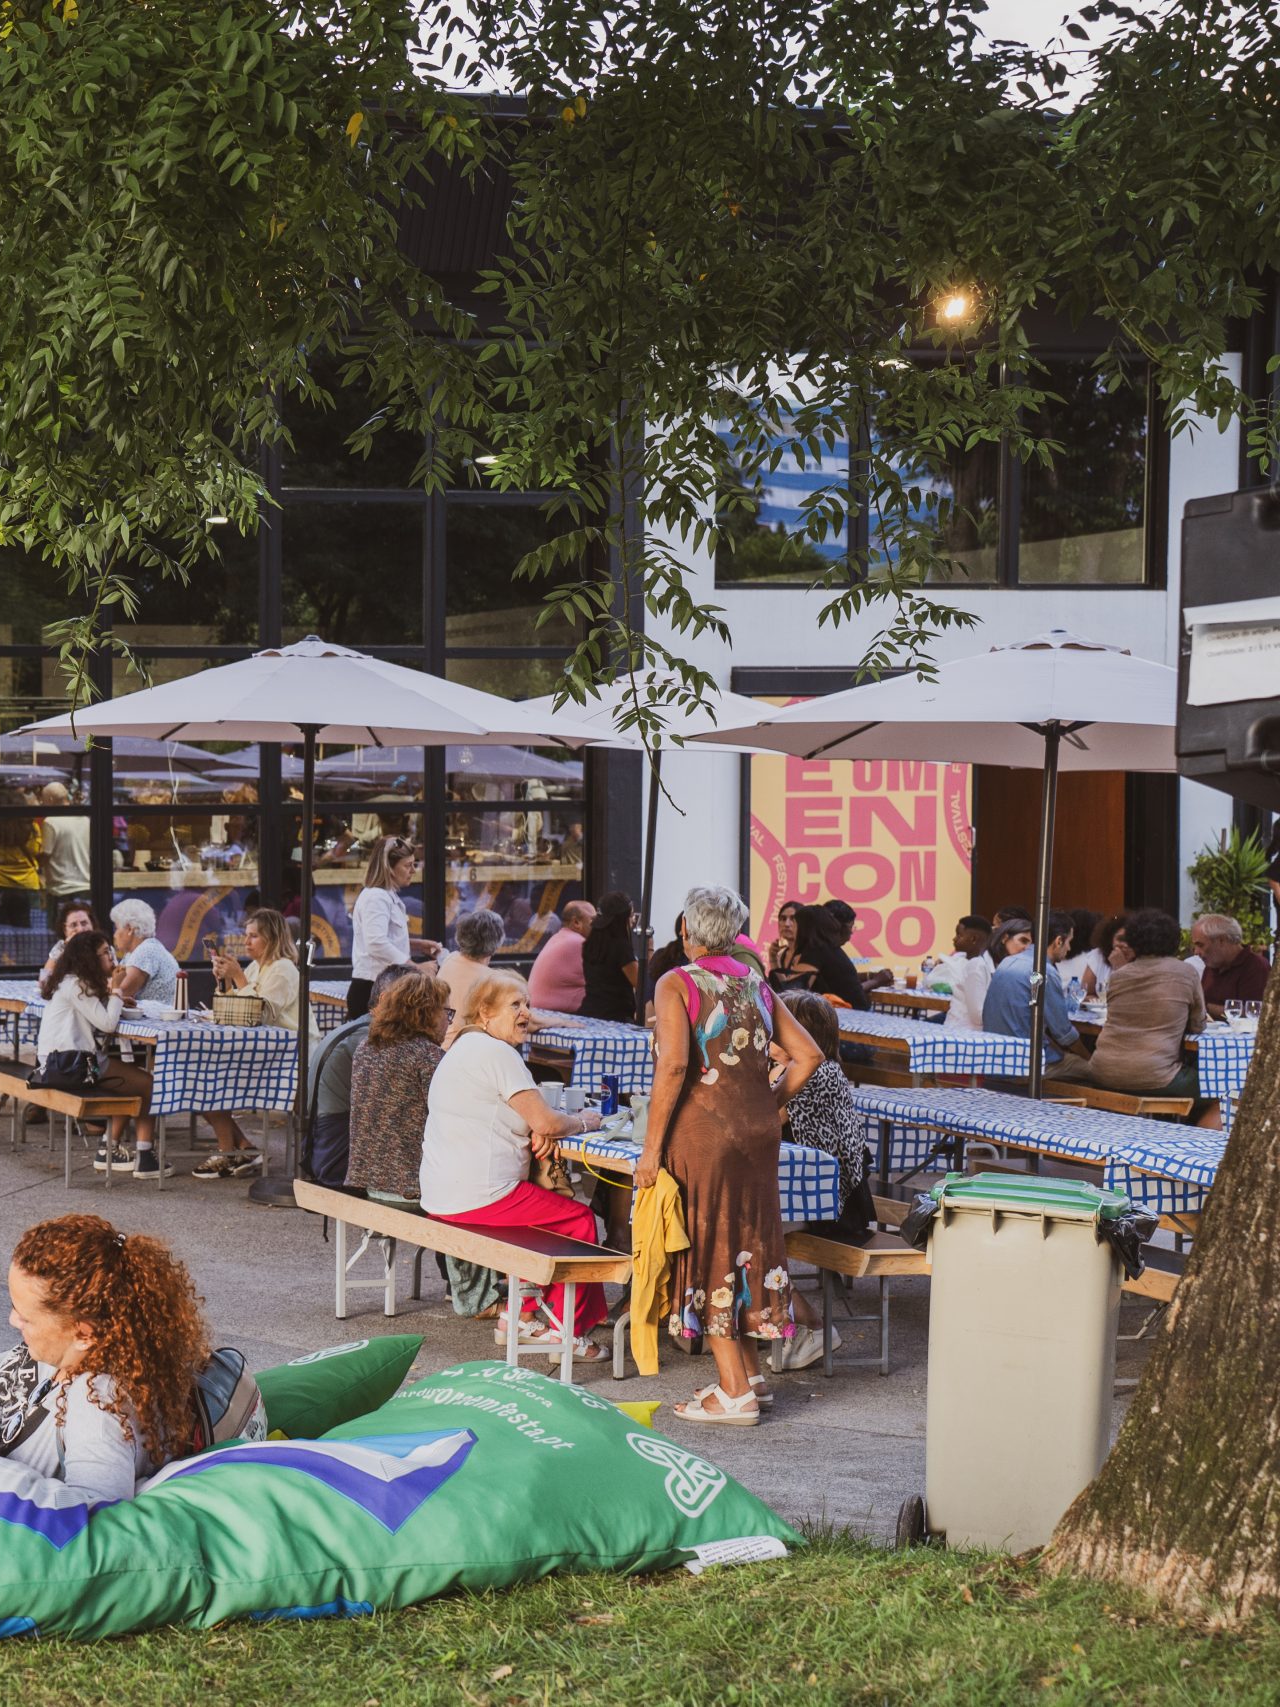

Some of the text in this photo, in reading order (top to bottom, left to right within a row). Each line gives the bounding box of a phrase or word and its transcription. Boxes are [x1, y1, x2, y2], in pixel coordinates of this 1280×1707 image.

[853, 760, 937, 792] UM
[785, 796, 937, 848] EN
[787, 851, 937, 903] CON
[849, 906, 936, 959] RO
